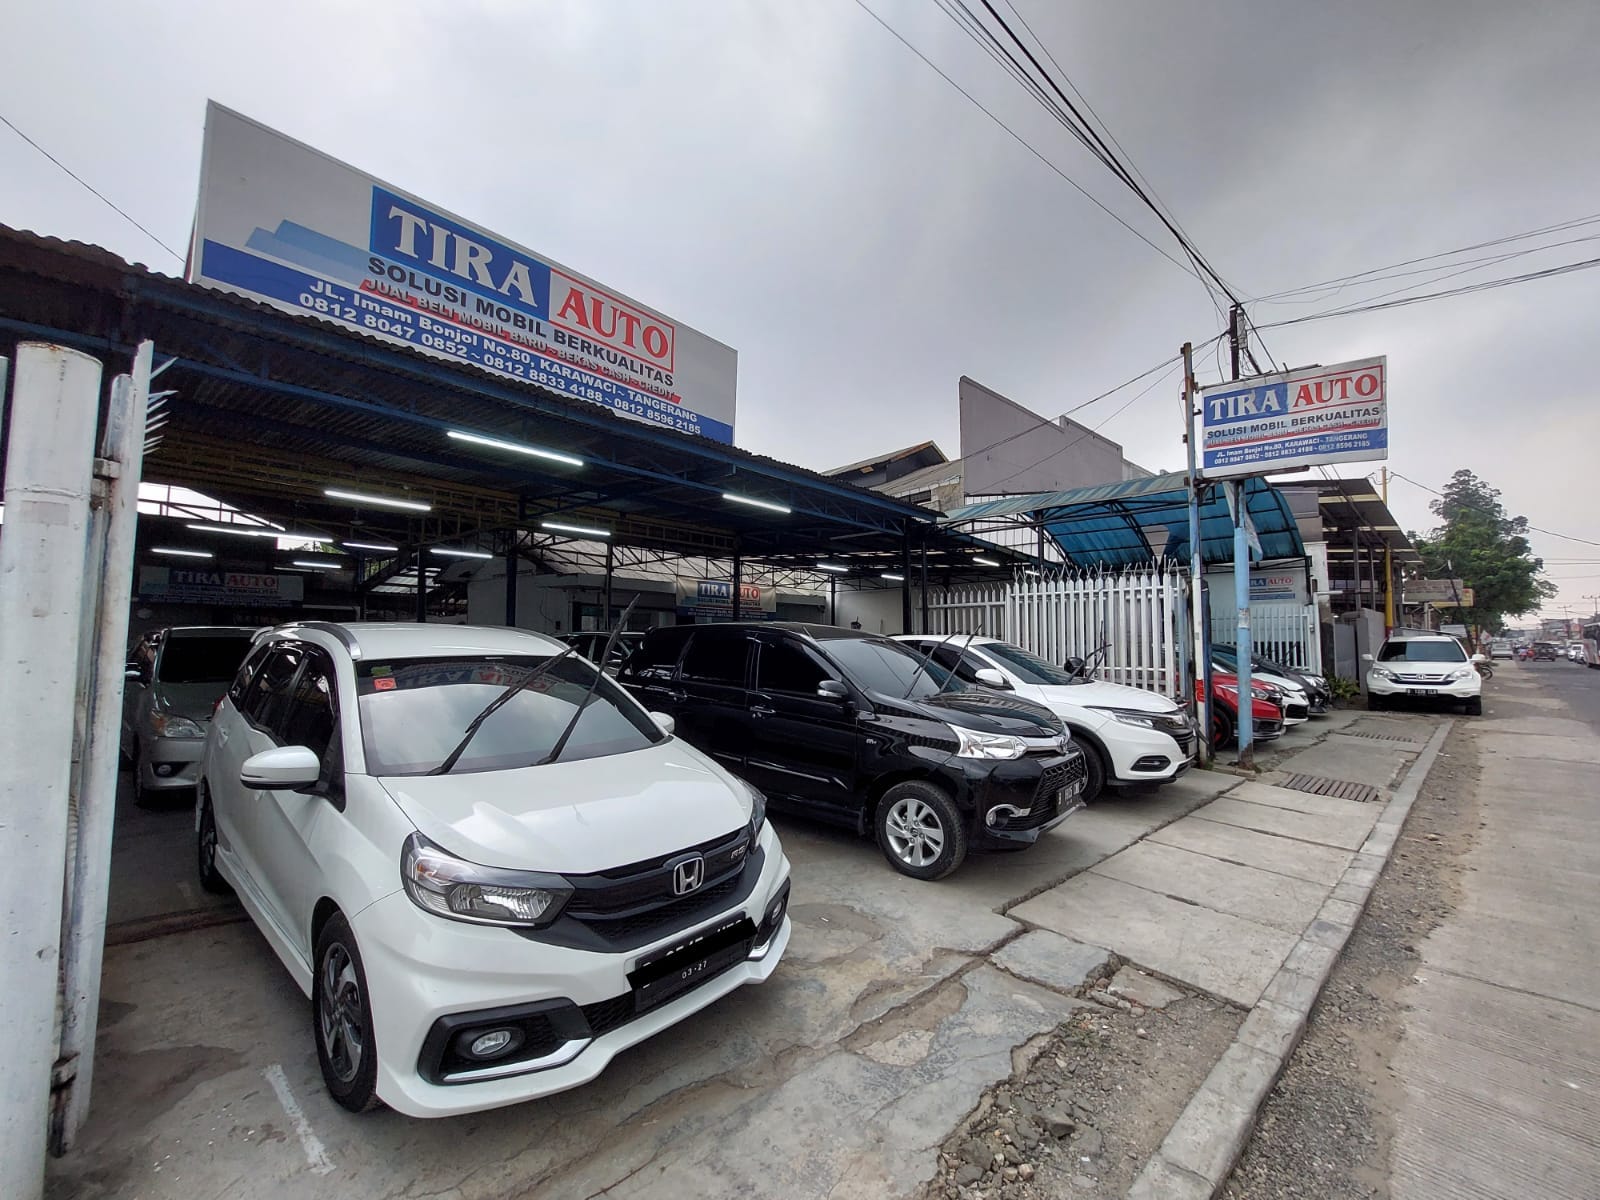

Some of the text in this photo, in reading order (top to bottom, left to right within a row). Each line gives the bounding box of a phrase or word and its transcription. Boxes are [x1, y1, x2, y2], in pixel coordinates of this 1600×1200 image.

[388, 205, 669, 359] TIRA AUTO
[366, 279, 410, 304] JUAL
[418, 297, 455, 318] BELI
[458, 311, 506, 339] MOBIL
[510, 331, 548, 353] BARU
[558, 349, 598, 370] BEKAS
[602, 365, 631, 383] CASH
[368, 257, 674, 387] SOLUSI MOBIL BERKUALITAS
[299, 293, 357, 322] 0812
[364, 314, 415, 339] 8047
[421, 333, 468, 358] 0852
[484, 355, 524, 376] 0812
[529, 369, 565, 390] 8833
[569, 384, 603, 402] 4188
[614, 398, 644, 415] 0812
[646, 410, 674, 426] 8596
[676, 419, 701, 434] 2185
[309, 280, 345, 302] JL.
[353, 293, 412, 324] Imam
[419, 316, 478, 346] Bonjol
[483, 338, 535, 368] No.80,
[627, 390, 698, 422] TANGERANG
[1210, 373, 1378, 421] TIRA AUTO
[1207, 426, 1247, 439] SOLUSI
[1250, 421, 1287, 433] MOBIL
[1291, 406, 1380, 427] BERKUALITAS
[1285, 438, 1320, 448] KARAWACI
[1325, 433, 1368, 443] TANGERANG
[175, 571, 276, 587] TIRA AUTO
[700, 583, 759, 599] TIRA UTO
[1267, 576, 1292, 585] AUTO
